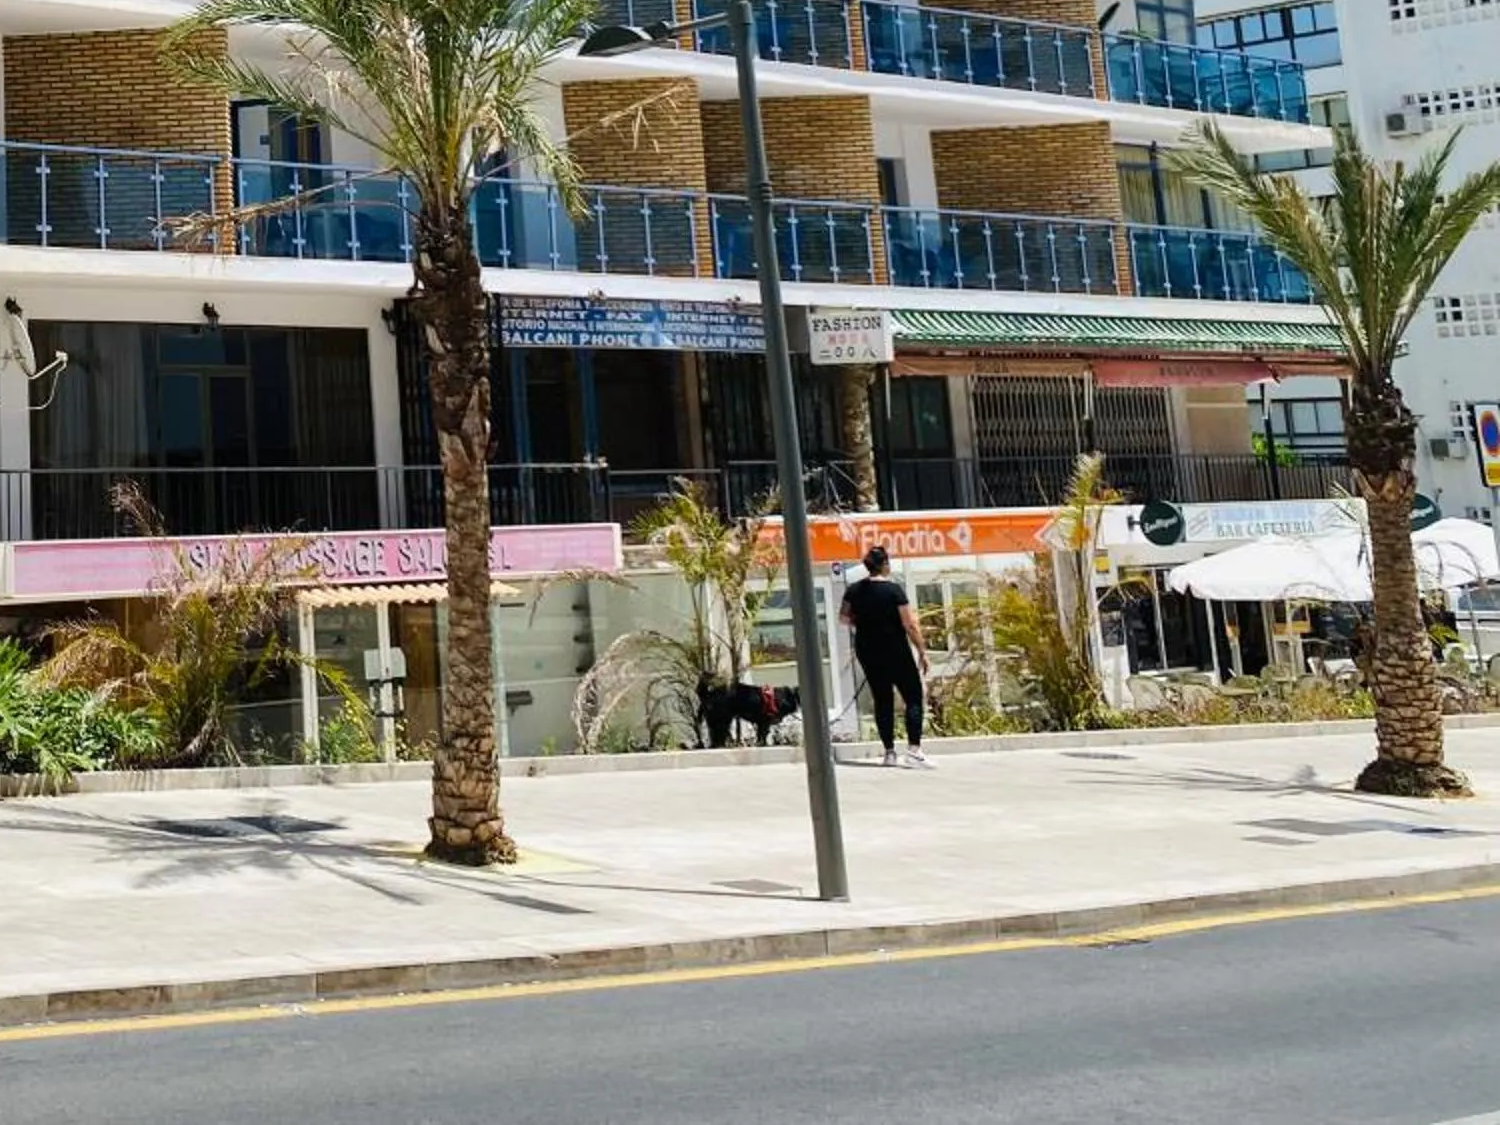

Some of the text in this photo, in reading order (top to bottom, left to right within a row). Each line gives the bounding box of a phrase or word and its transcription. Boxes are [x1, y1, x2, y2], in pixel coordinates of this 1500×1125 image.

[501, 308, 587, 320] TERNET
[605, 310, 642, 321] FAX
[666, 313, 736, 324] INTERNET
[812, 316, 882, 332] FASHION
[501, 330, 574, 345] BALCANI
[674, 332, 726, 348] BALCANI
[860, 521, 946, 557] Flandria
[270, 535, 387, 578] SSAGE
